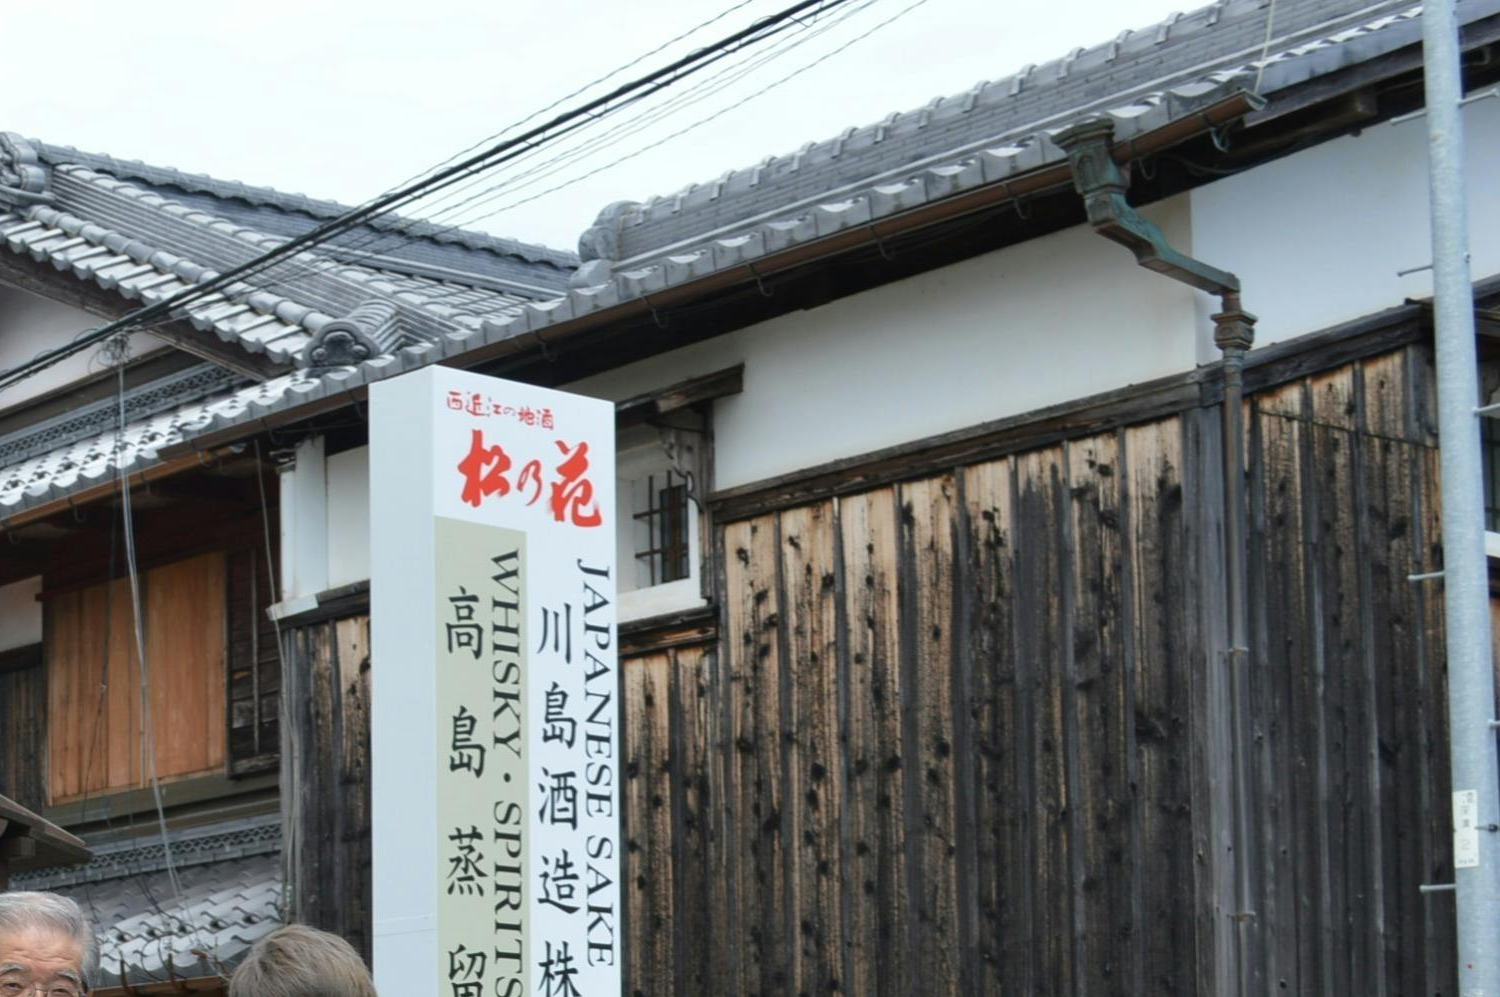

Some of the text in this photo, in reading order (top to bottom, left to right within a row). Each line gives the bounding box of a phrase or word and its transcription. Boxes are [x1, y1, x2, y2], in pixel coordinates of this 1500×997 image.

[447, 391, 554, 430] 西近江の地酒
[576, 558, 614, 968] JAPANESE SAKE
